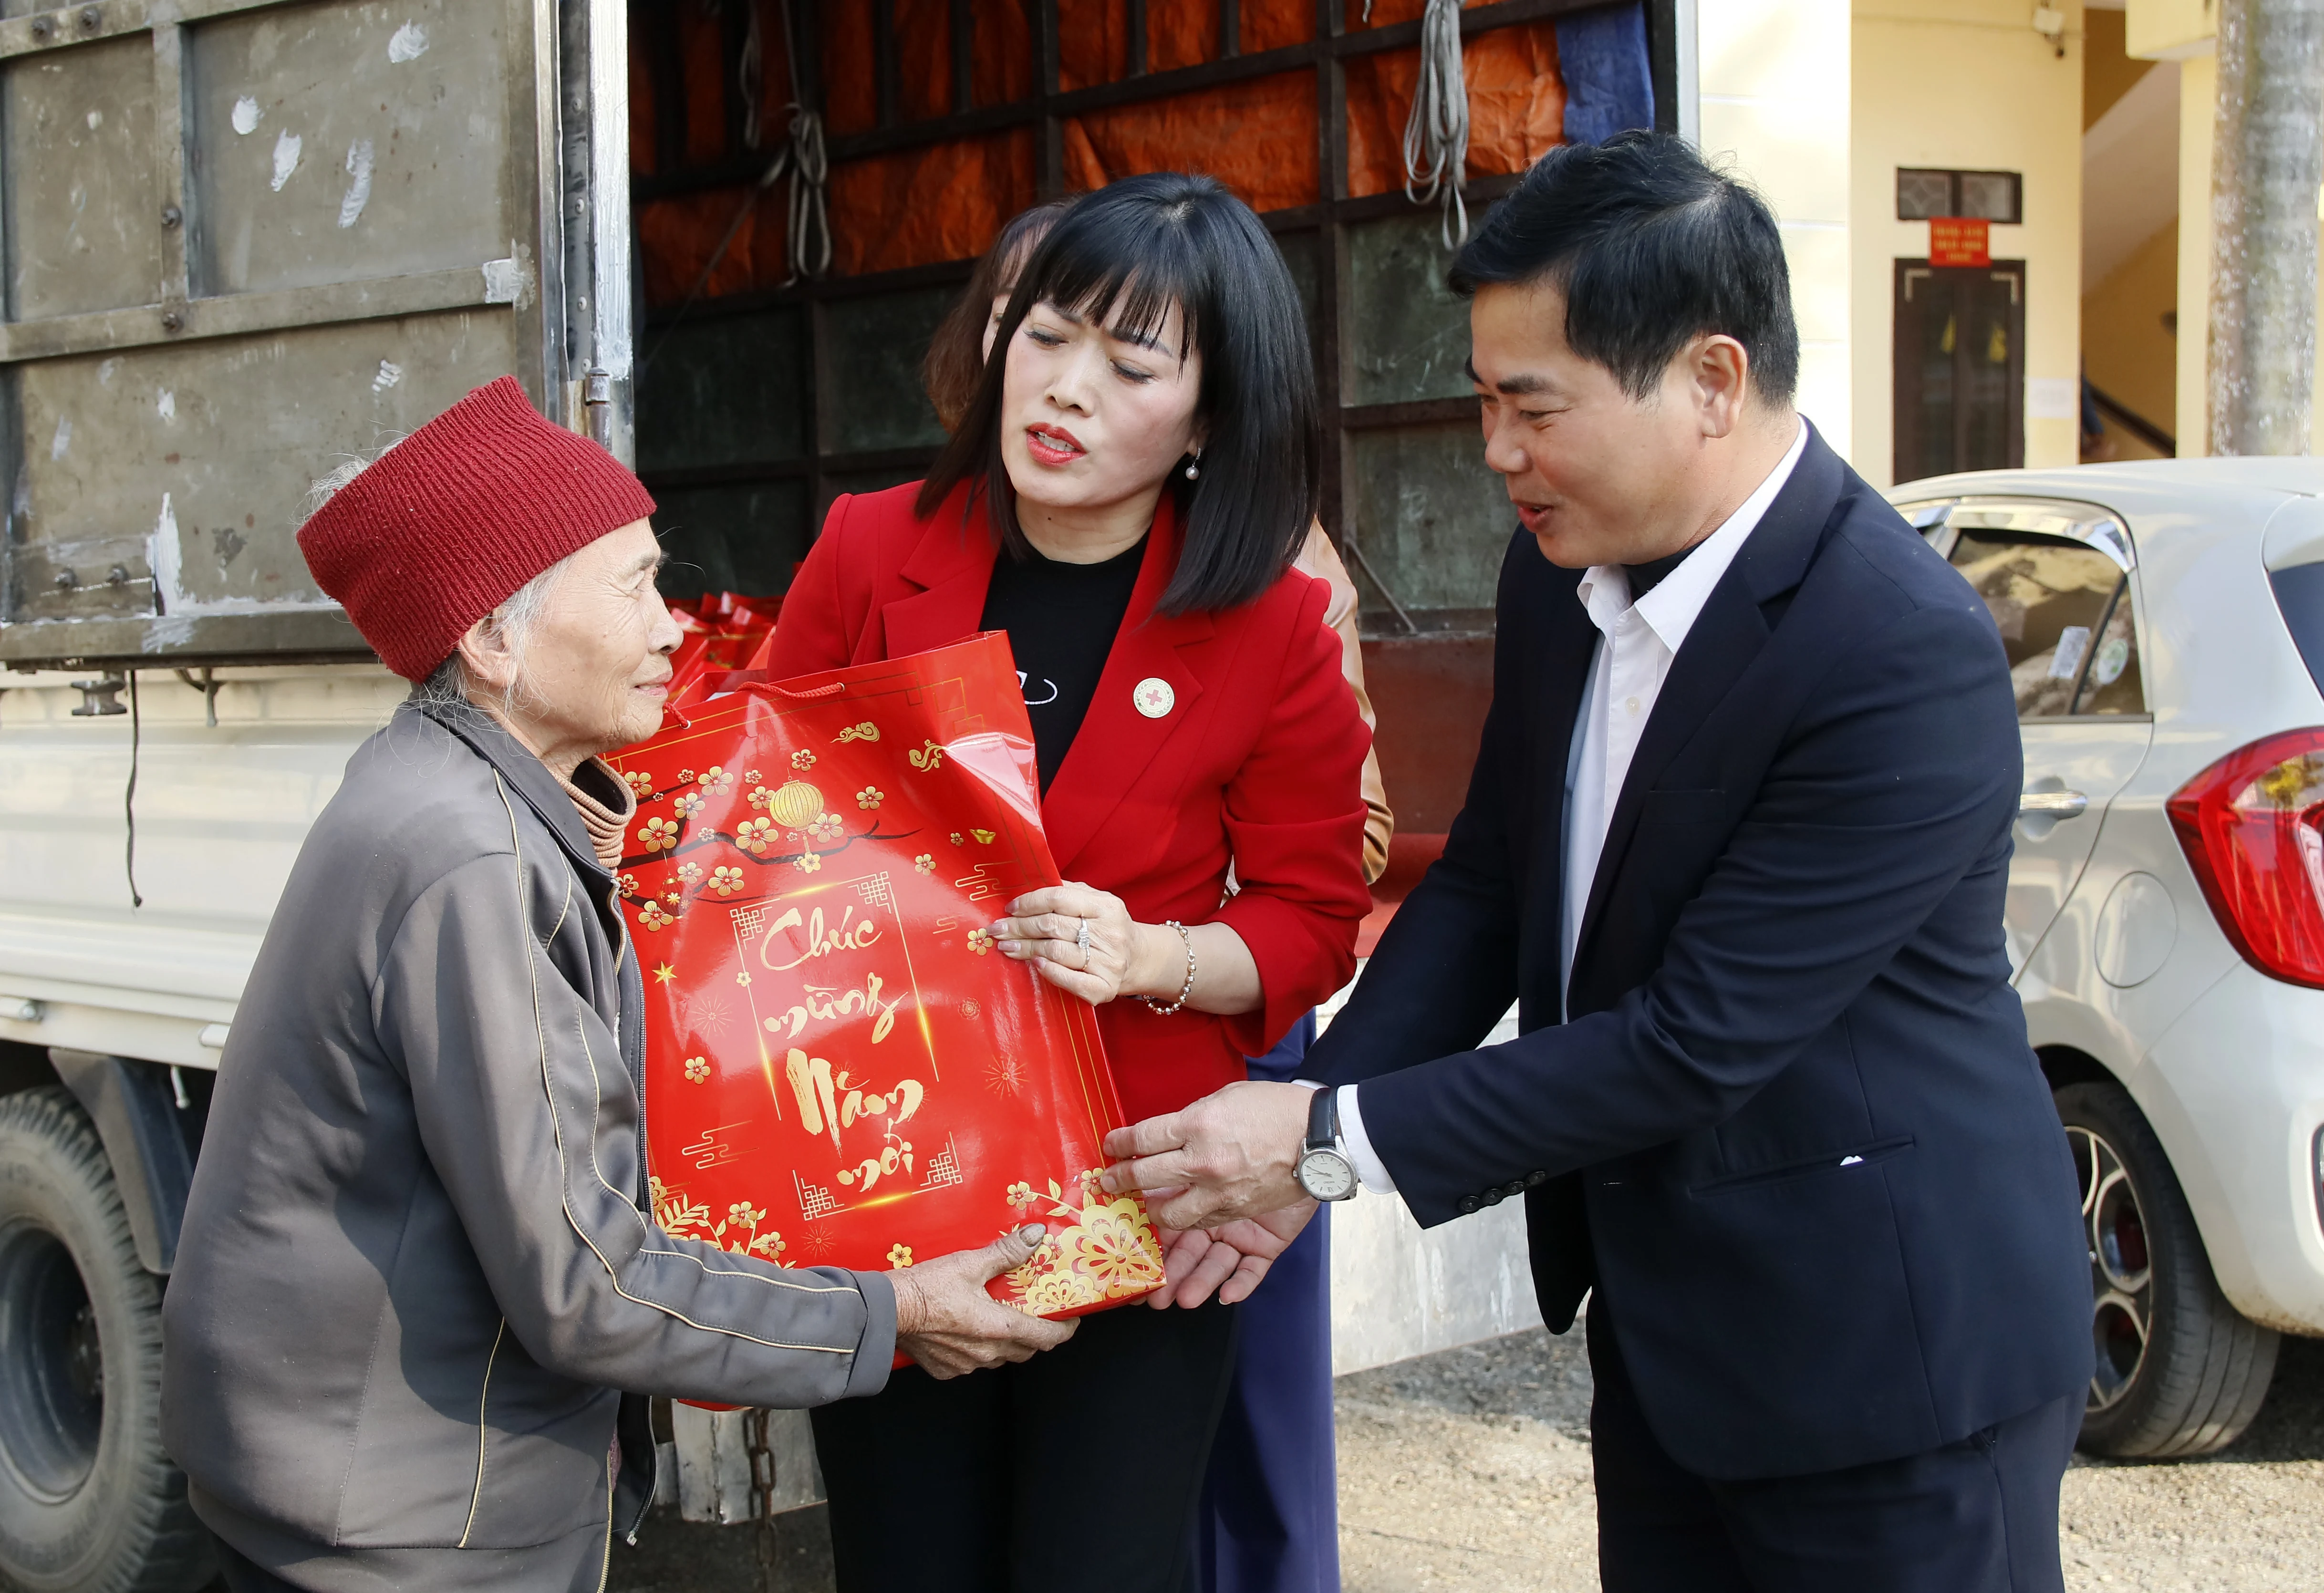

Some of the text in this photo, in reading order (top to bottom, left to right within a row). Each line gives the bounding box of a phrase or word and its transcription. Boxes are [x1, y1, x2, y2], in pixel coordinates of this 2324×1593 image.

[760, 905, 882, 971] Chúc
[763, 972, 908, 1044] mừng
[786, 1048, 923, 1161] Năm
[836, 1118, 914, 1192] mới
